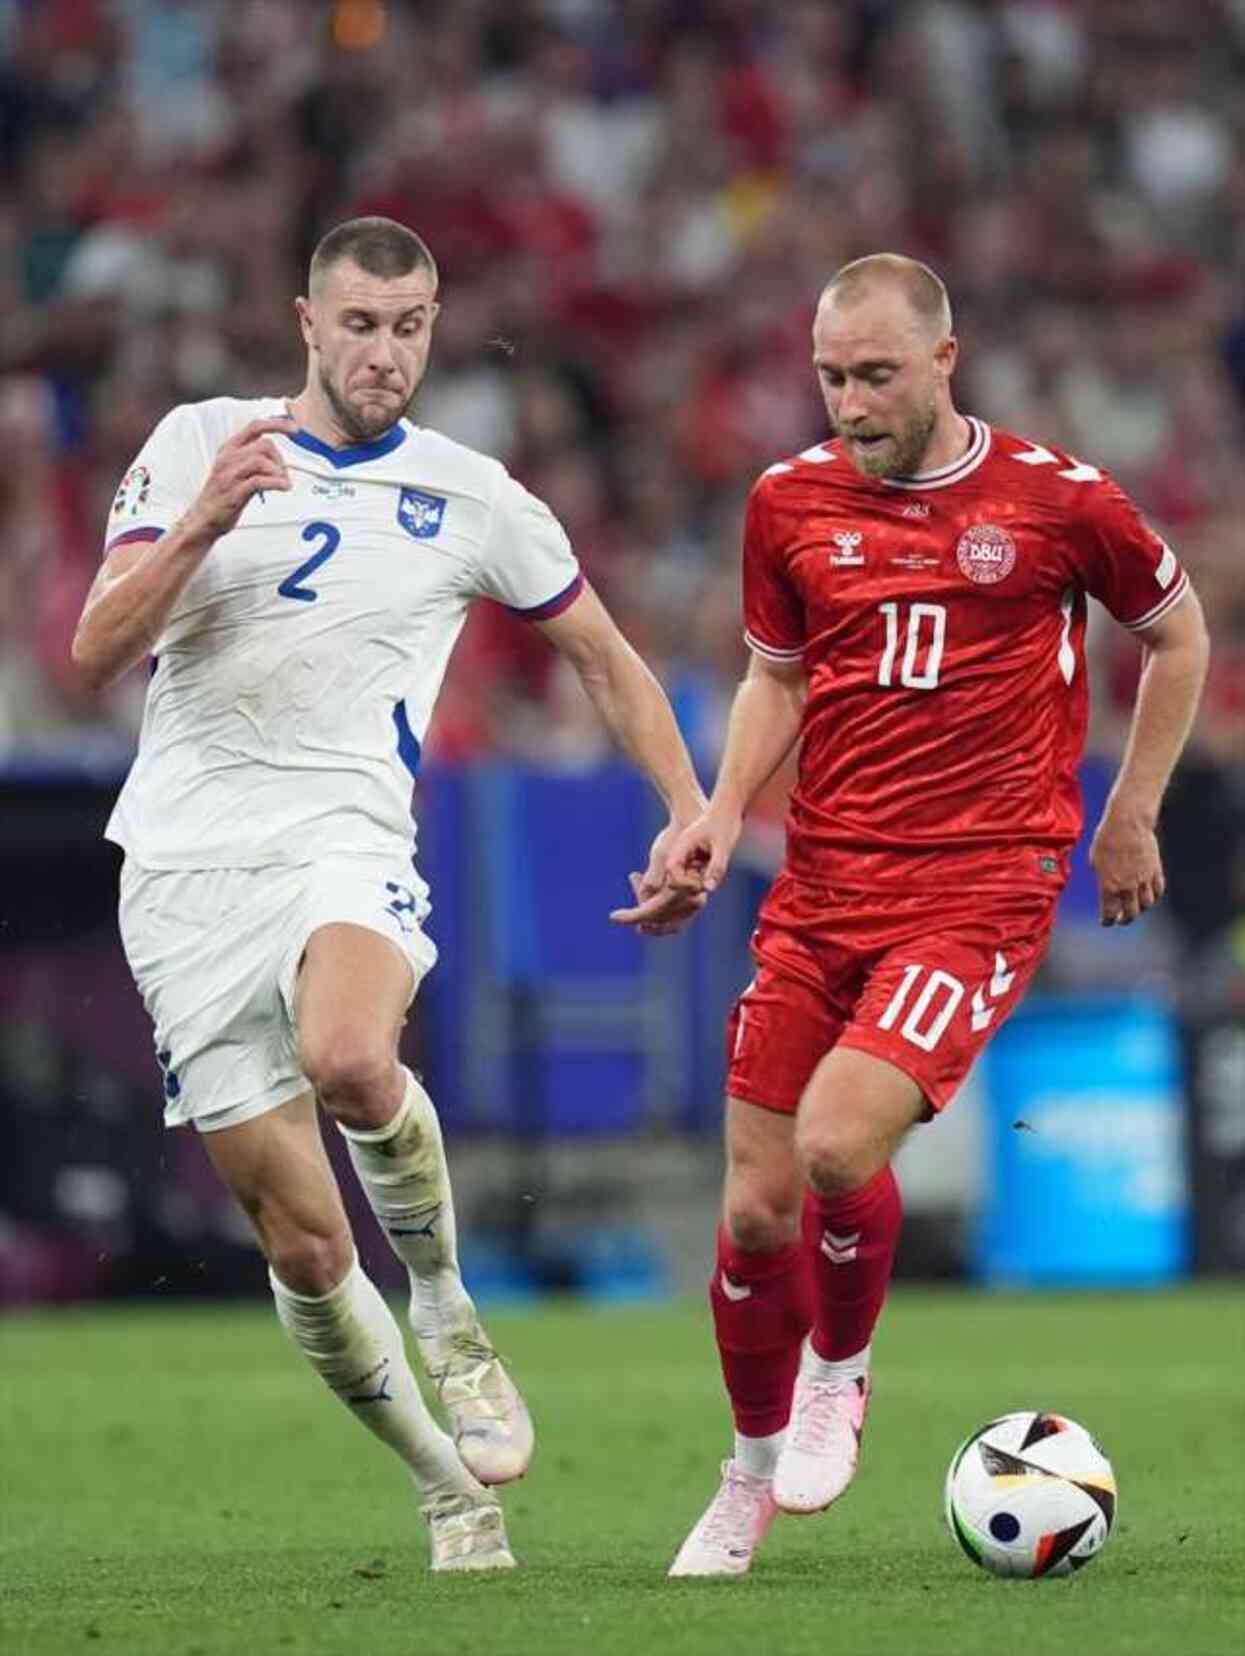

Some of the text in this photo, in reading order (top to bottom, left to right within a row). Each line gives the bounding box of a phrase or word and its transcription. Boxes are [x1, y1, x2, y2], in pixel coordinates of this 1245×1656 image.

[278, 521, 341, 602] 2
[878, 602, 946, 690] 10
[877, 964, 964, 1051] 10
